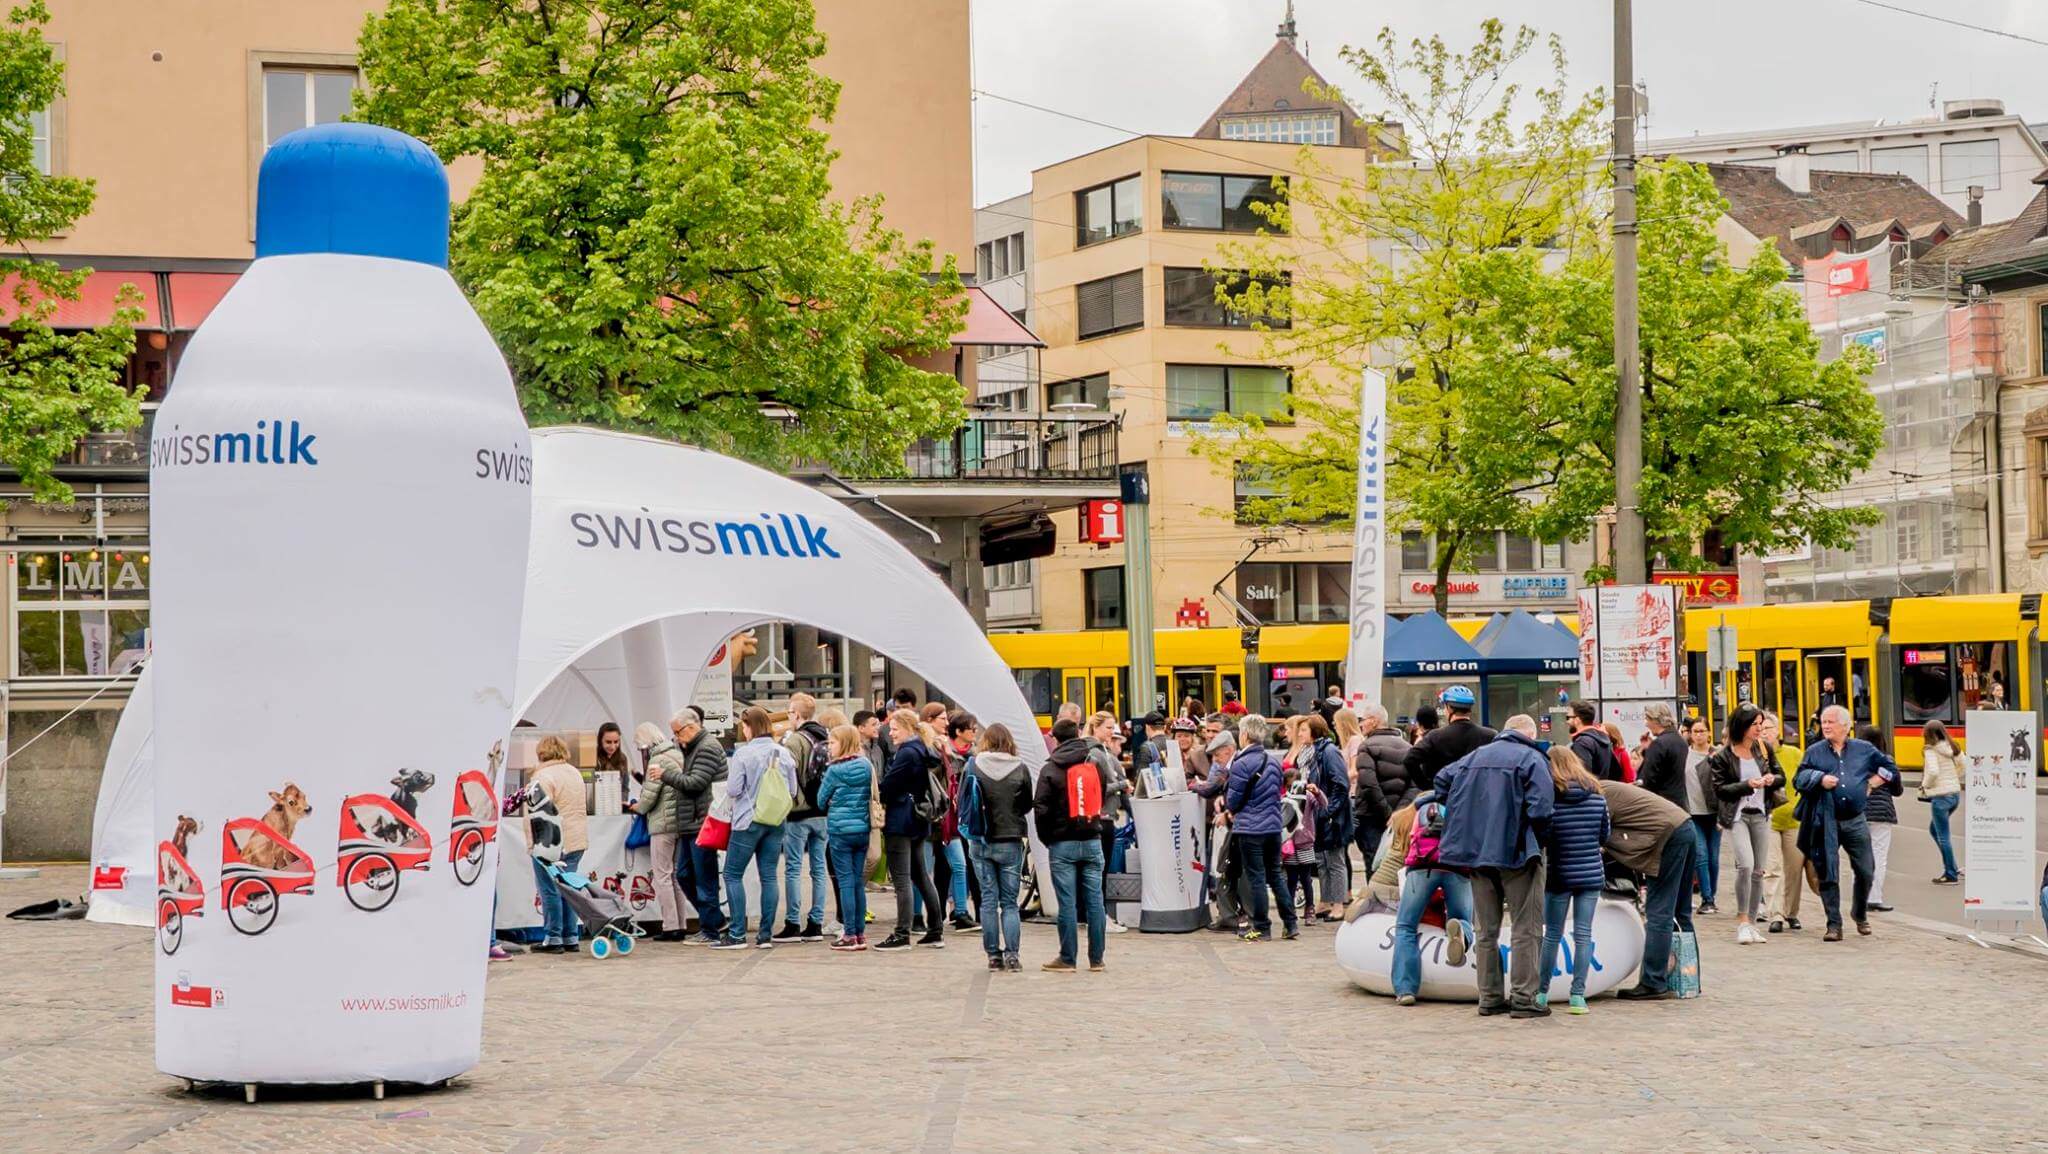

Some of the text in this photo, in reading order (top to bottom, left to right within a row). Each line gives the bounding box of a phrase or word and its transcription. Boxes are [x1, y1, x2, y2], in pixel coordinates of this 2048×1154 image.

[476, 442, 532, 485] swiss
[570, 506, 841, 559] swissmilk
[1098, 502, 1122, 538] i
[1246, 585, 1281, 600] Salt.
[1417, 661, 1478, 672] Telefon
[1544, 659, 1580, 670] Telef
[1171, 813, 1185, 894] swissmilk
[341, 990, 467, 1011] www.swissmilk.ch
